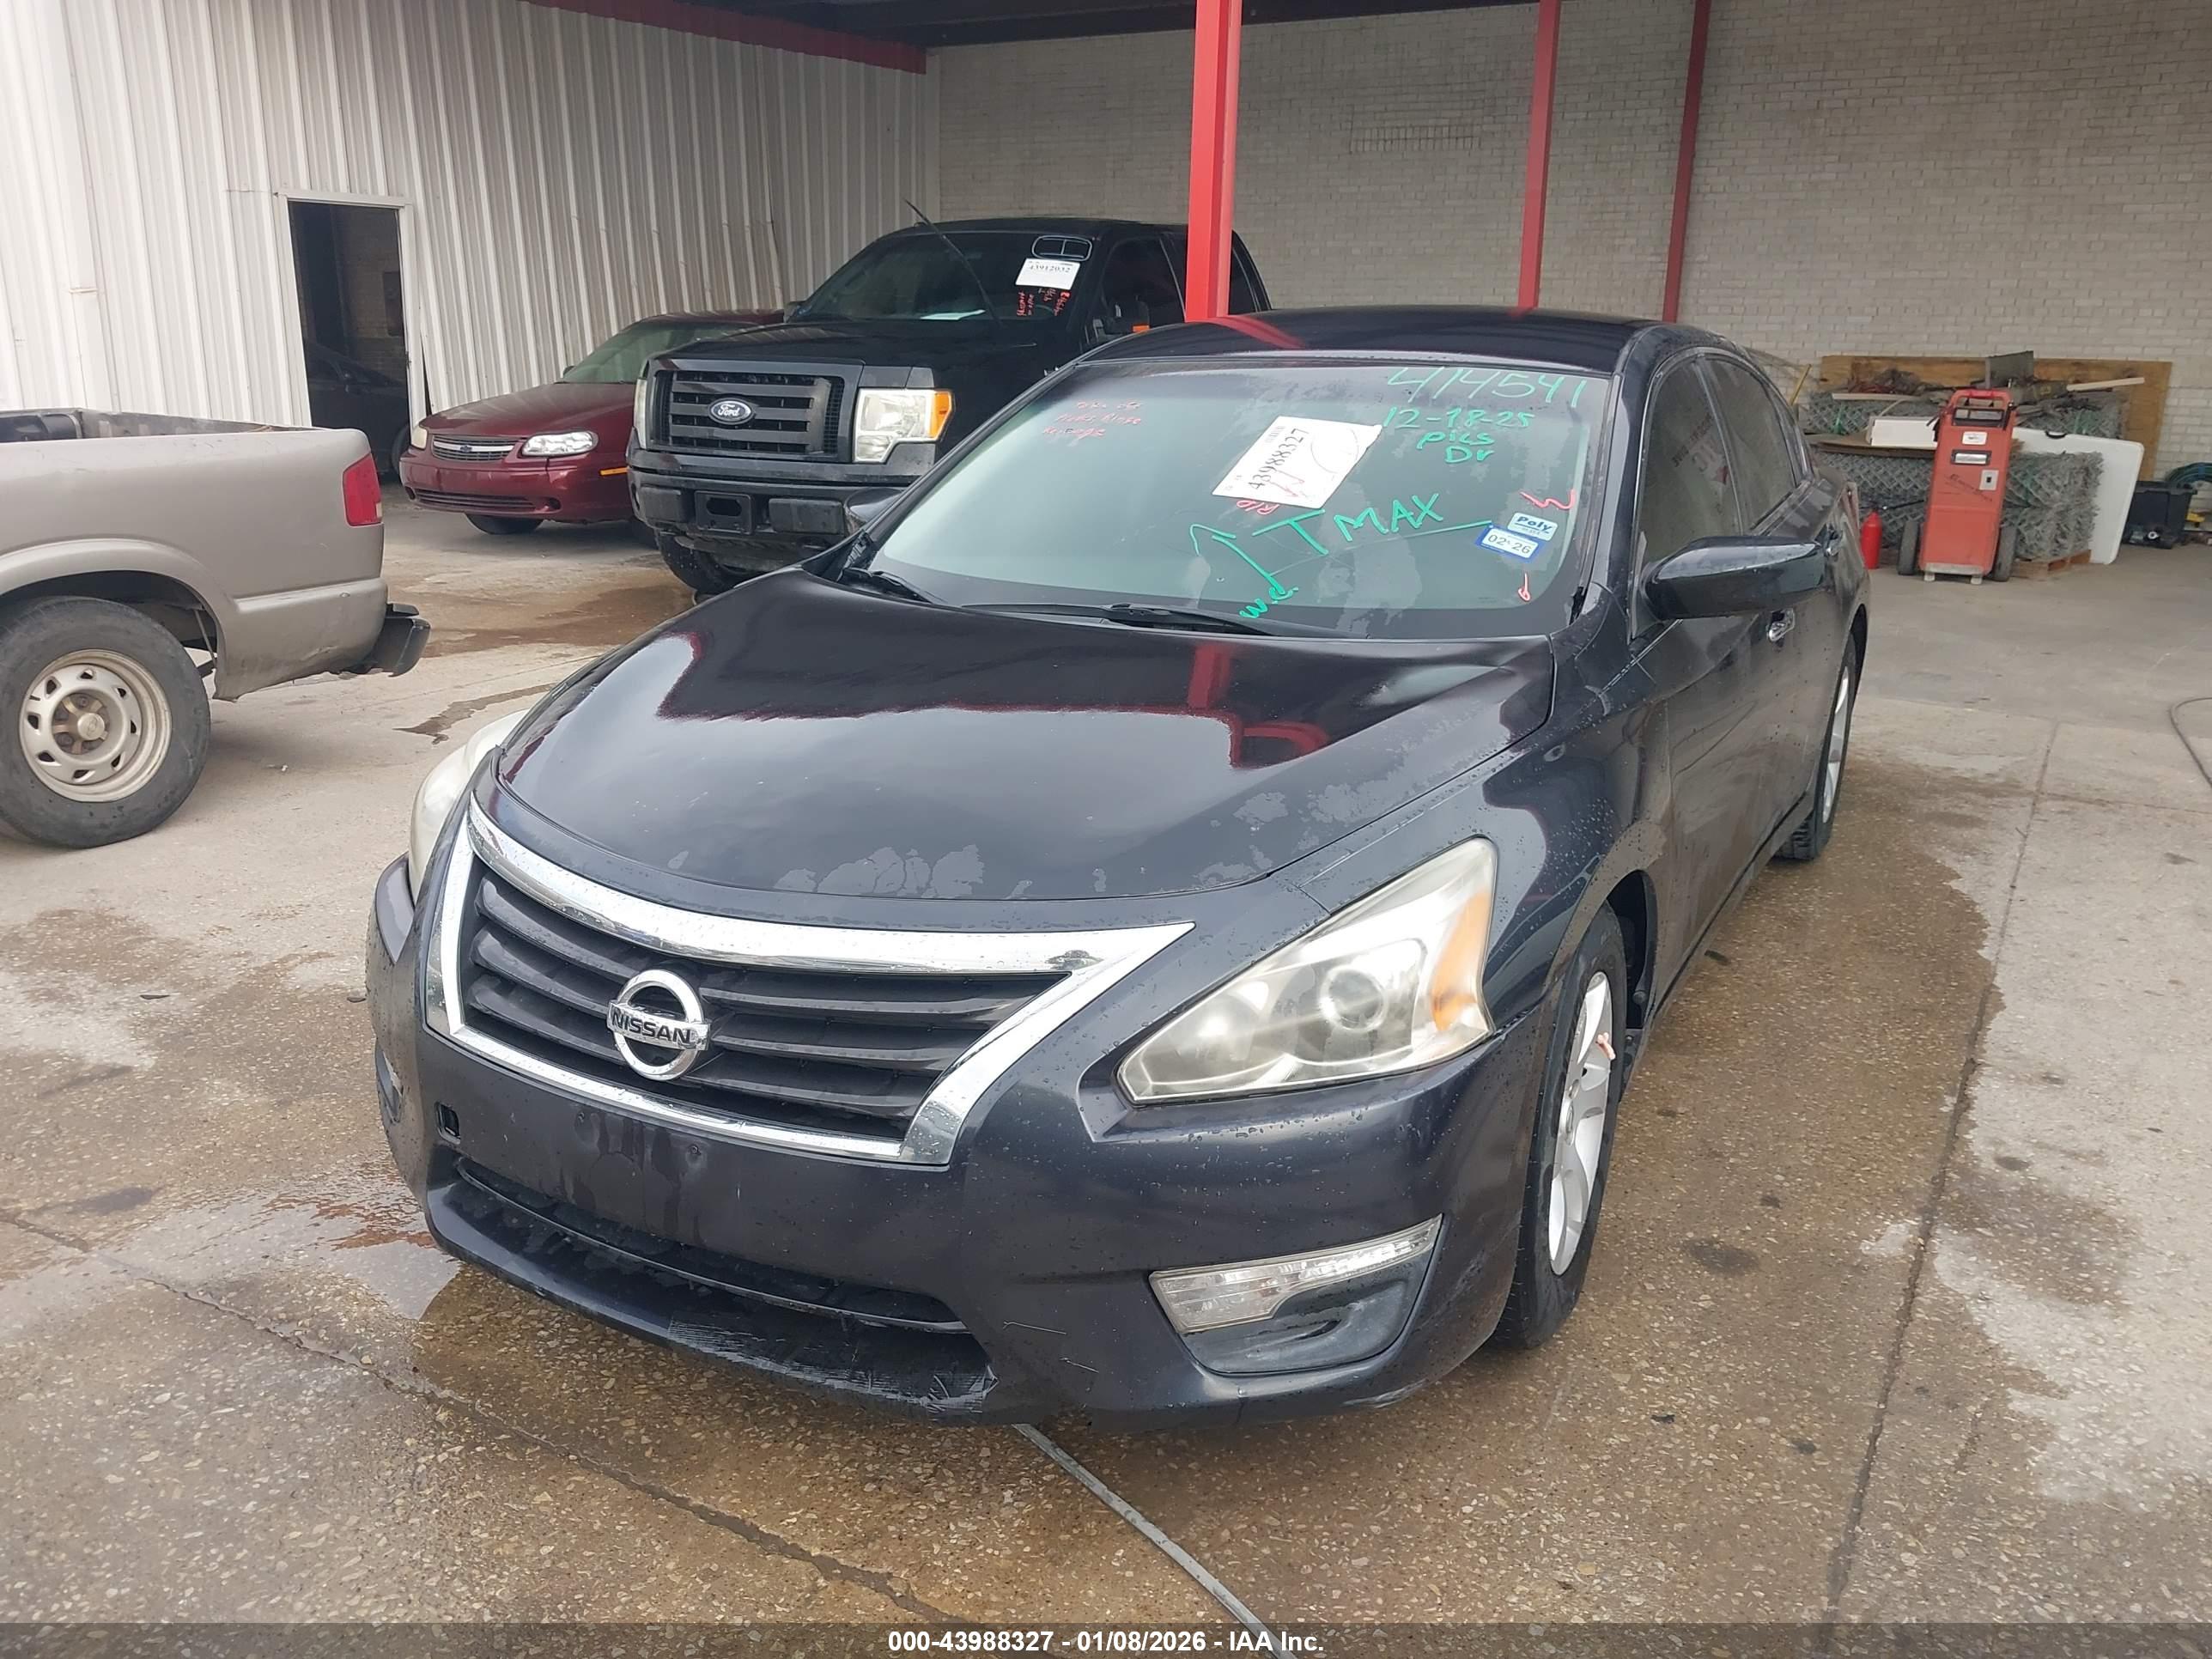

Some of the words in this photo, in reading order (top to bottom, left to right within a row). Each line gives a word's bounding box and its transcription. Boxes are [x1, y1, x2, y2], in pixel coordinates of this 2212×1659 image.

[717, 404, 741, 417] Ford
[1248, 427, 1310, 489] 43988327
[1516, 516, 1553, 532] Poly
[611, 1007, 692, 1044] NISSAN
